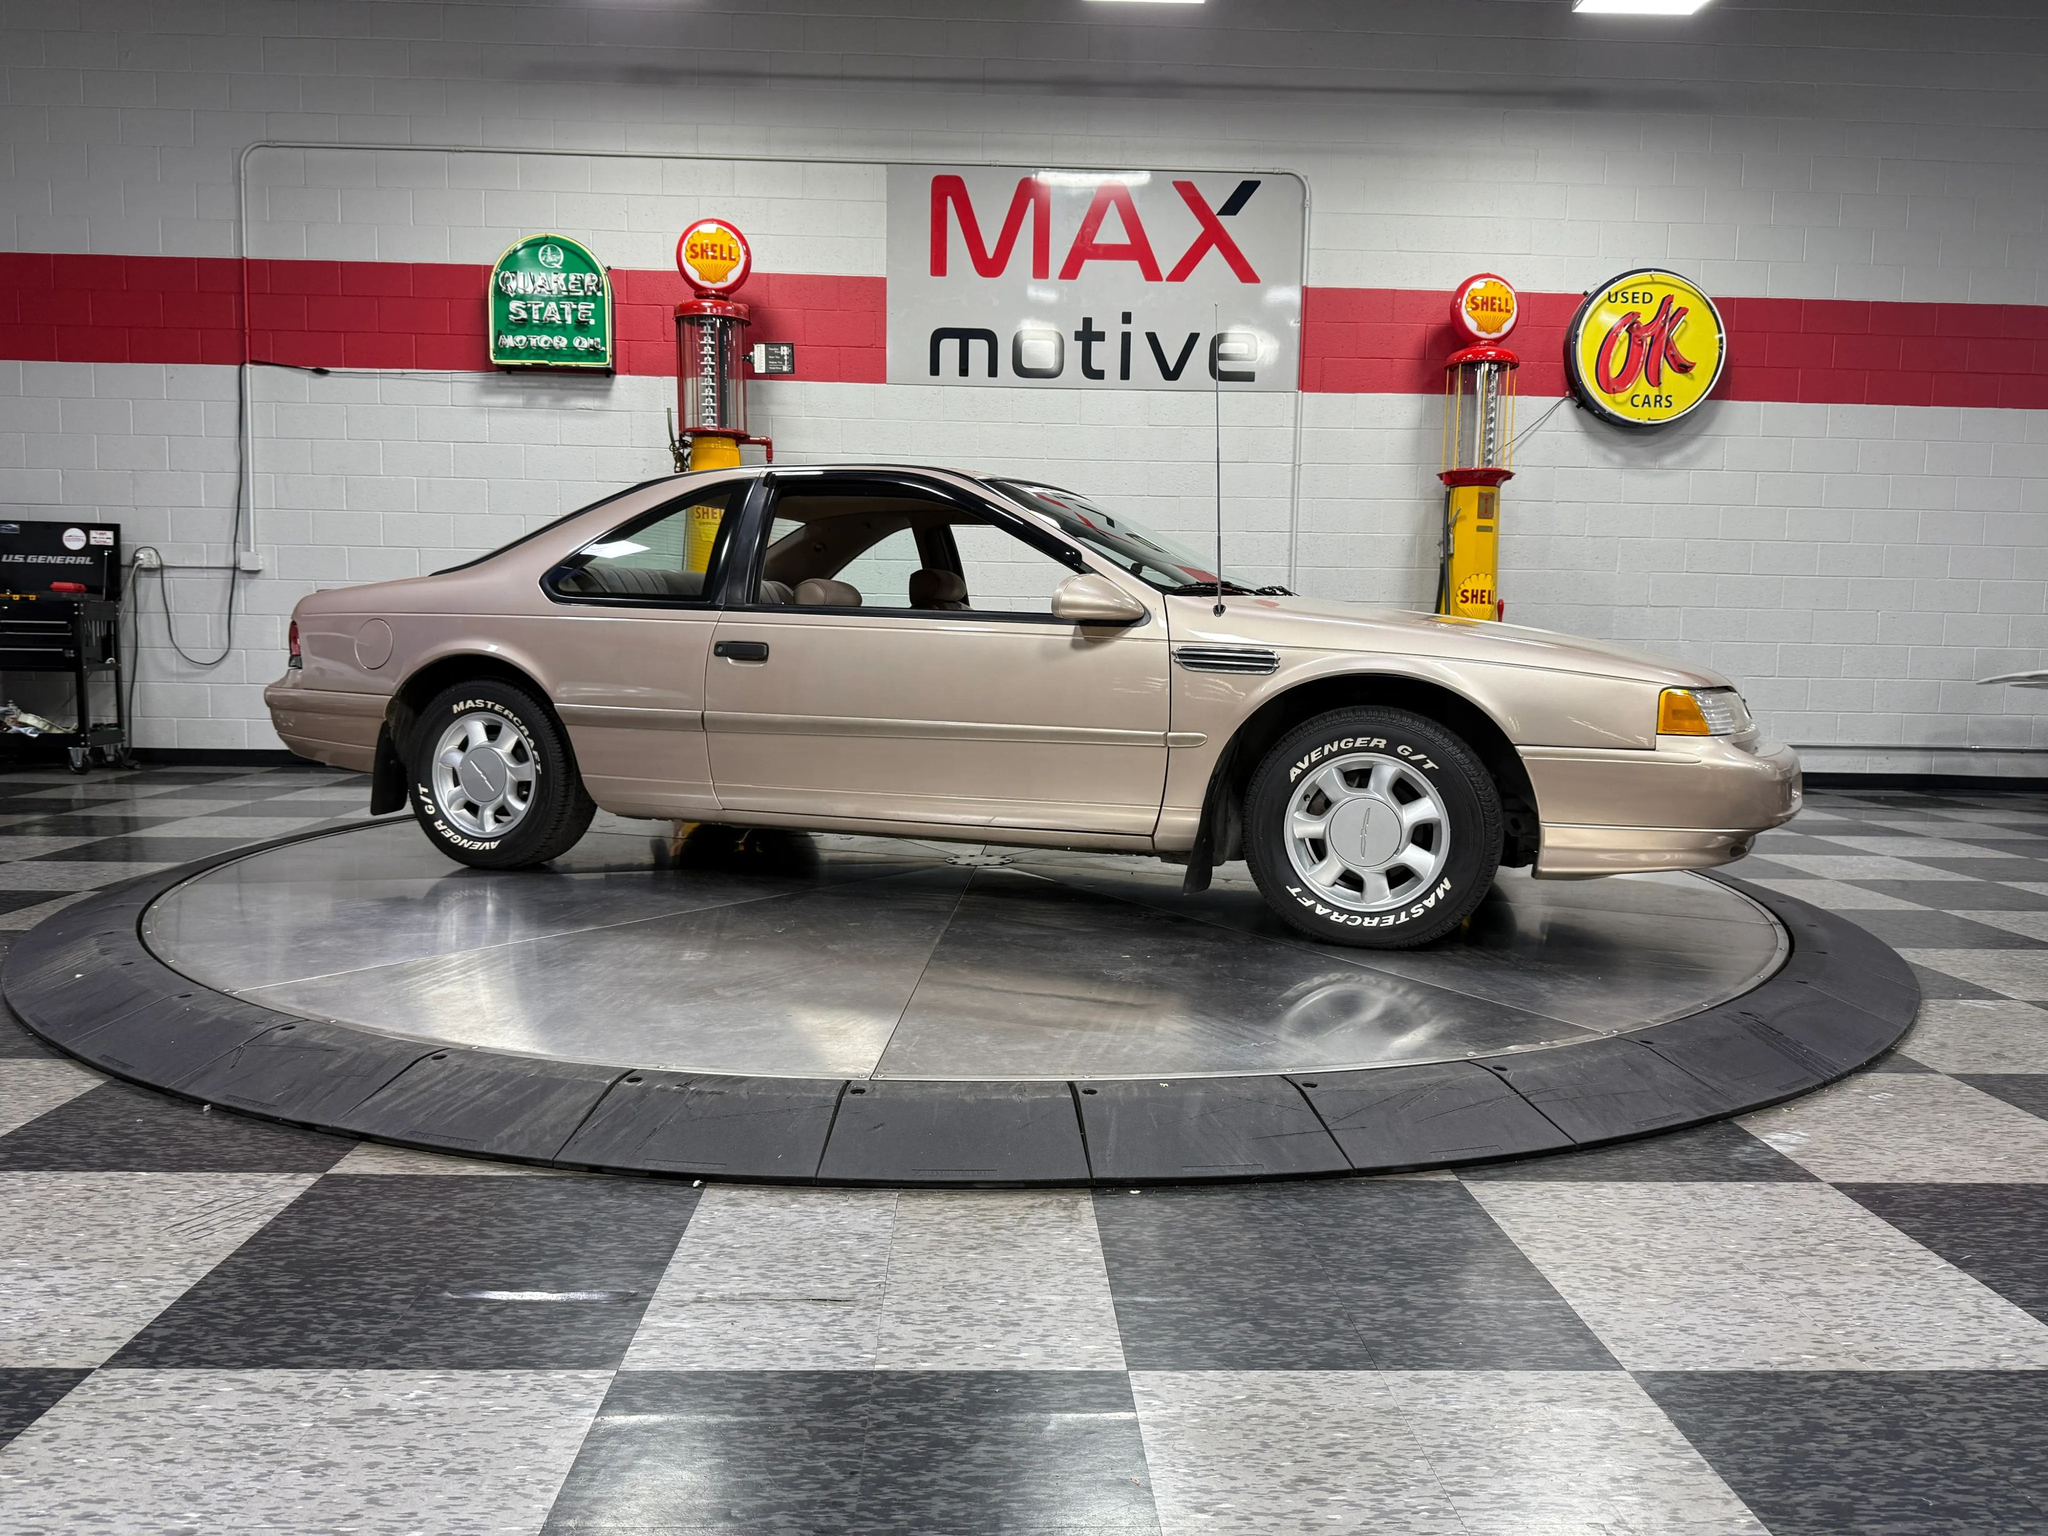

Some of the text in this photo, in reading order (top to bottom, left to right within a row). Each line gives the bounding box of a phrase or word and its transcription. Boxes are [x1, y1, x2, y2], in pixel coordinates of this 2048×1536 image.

[930, 174, 1261, 284] MAX
[689, 243, 736, 261] SHELL
[499, 270, 603, 297] QUAKER
[1470, 295, 1511, 313] SHELL
[1607, 291, 1653, 304] USED
[508, 300, 596, 325] STATE
[498, 335, 568, 350] MOTOR
[930, 311, 1258, 382] motive
[1630, 394, 1673, 408] CARS
[26, 555, 94, 565] GENERAL
[452, 699, 543, 775] MASTERCRAFT
[1288, 737, 1440, 783] AVENGER G/T
[417, 782, 503, 851] AVENGER G/T
[1285, 877, 1453, 928] MASTERCRAFT
